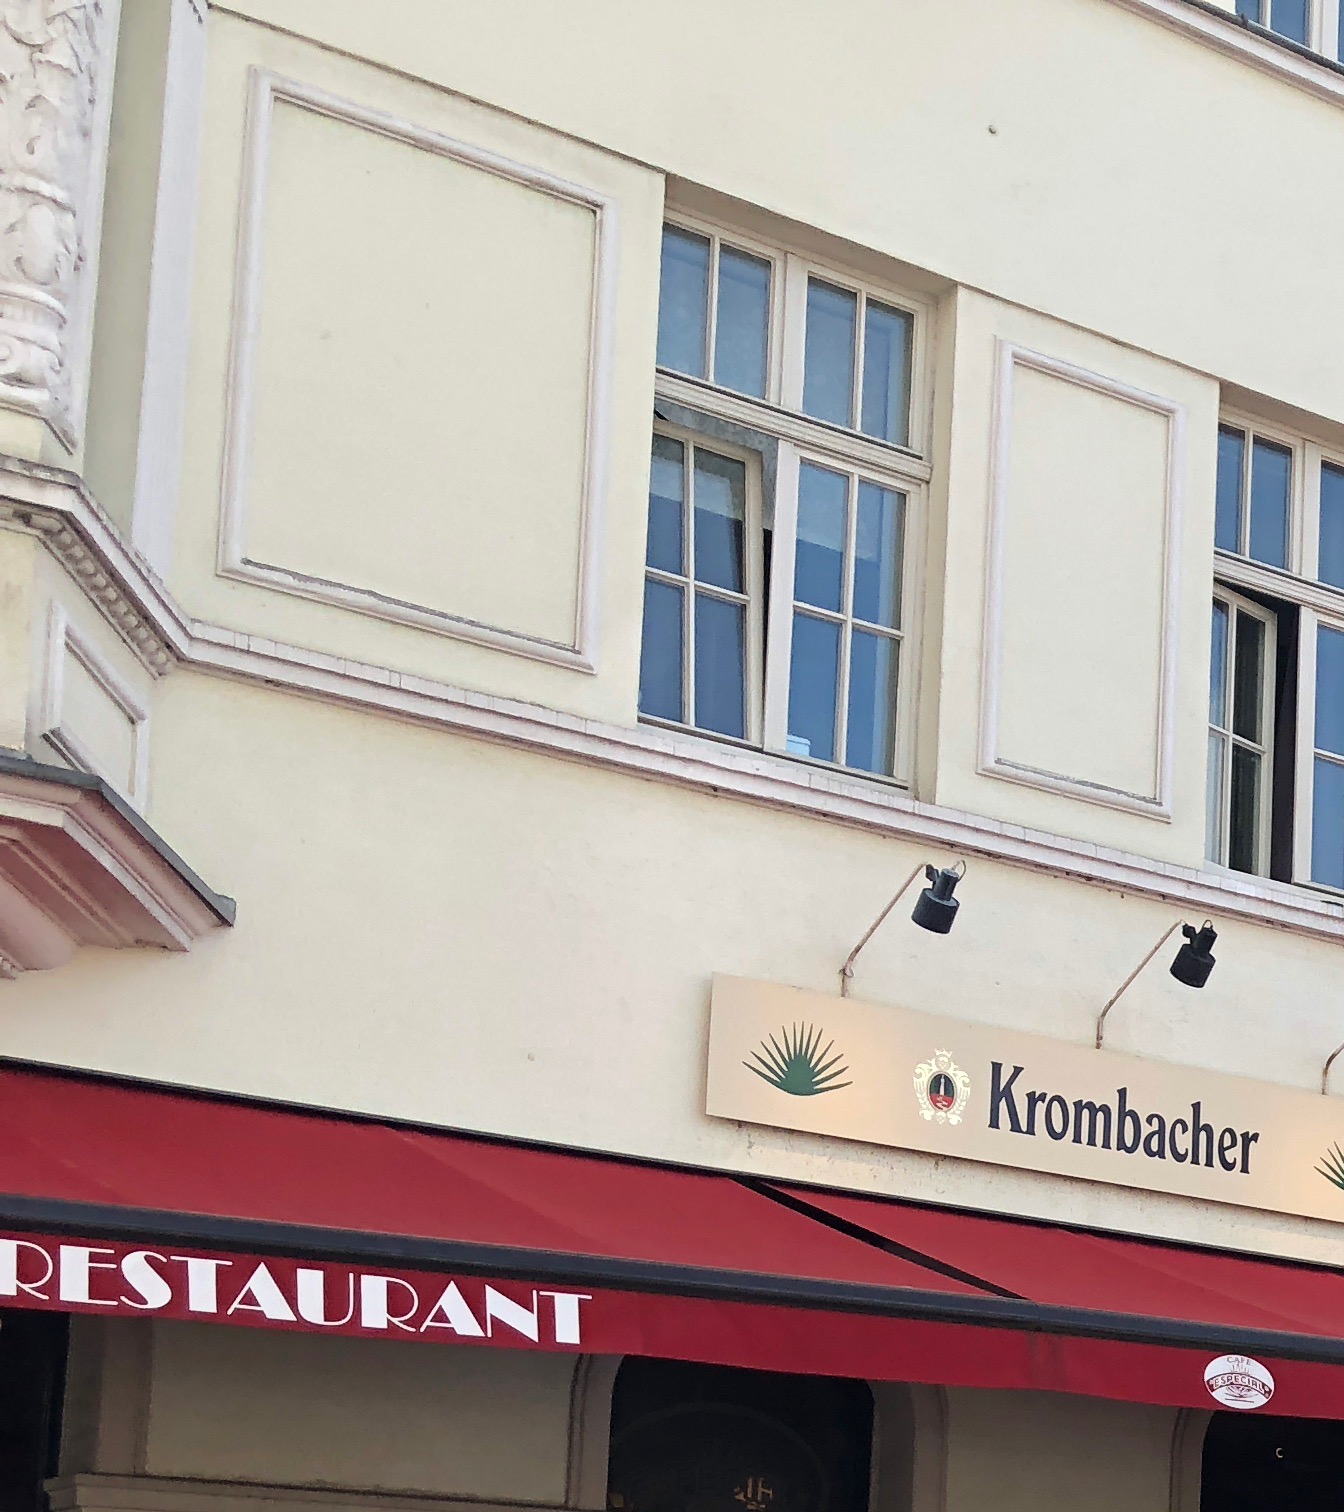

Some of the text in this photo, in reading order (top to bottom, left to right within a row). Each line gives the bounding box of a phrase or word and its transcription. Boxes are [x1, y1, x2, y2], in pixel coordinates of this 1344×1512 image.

[988, 1060, 1260, 1175] Krombacher
[0, 1237, 593, 1345] RESTAURANT
[1214, 1375, 1265, 1392] ESPECIAL
